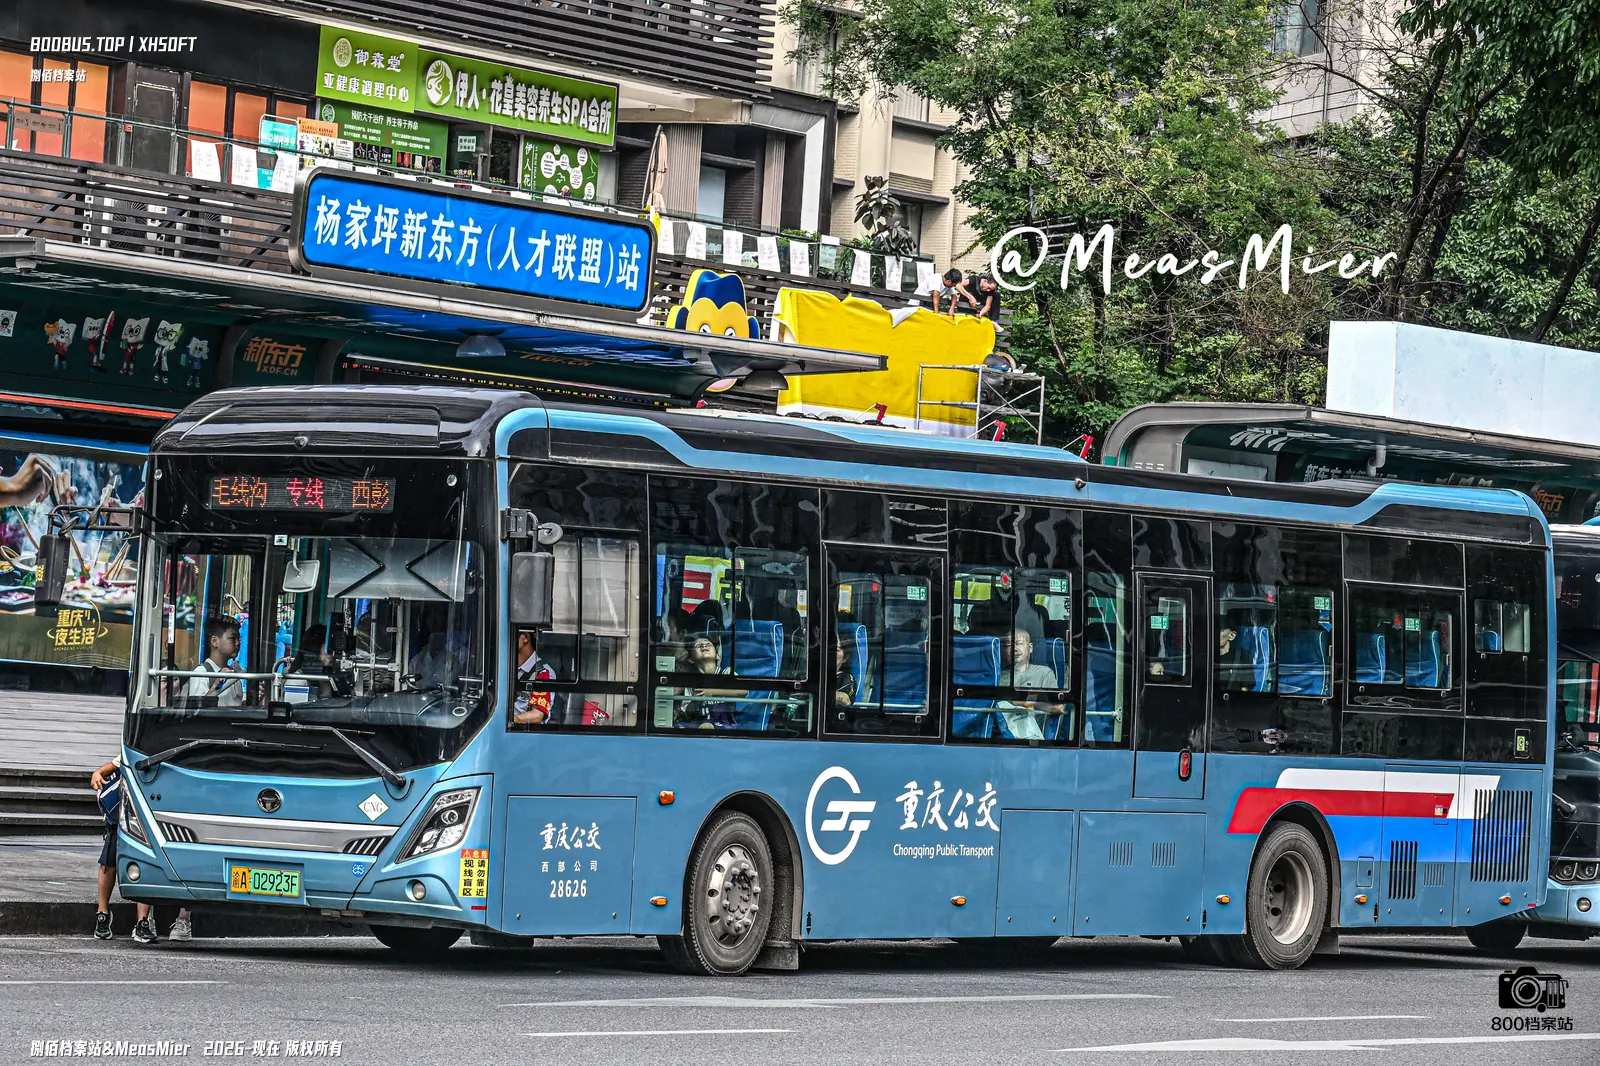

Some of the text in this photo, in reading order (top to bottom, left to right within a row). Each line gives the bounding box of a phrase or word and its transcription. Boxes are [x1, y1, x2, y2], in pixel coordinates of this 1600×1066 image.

[323, 72, 409, 103] 亚健康调理中心
[243, 336, 307, 372] 新东方
[262, 366, 298, 376] XDF.CN
[286, 477, 324, 509] 专线
[352, 479, 390, 508] 西彭
[56, 609, 84, 627] 重庆
[55, 627, 95, 646] 夜生活
[363, 801, 384, 813] CNG
[895, 780, 1000, 832] 重庆公交
[539, 822, 601, 850] 重庆公交
[893, 843, 994, 859] Chongqing Public Transport
[541, 860, 598, 873] 西部公司
[550, 879, 587, 898] 28626
